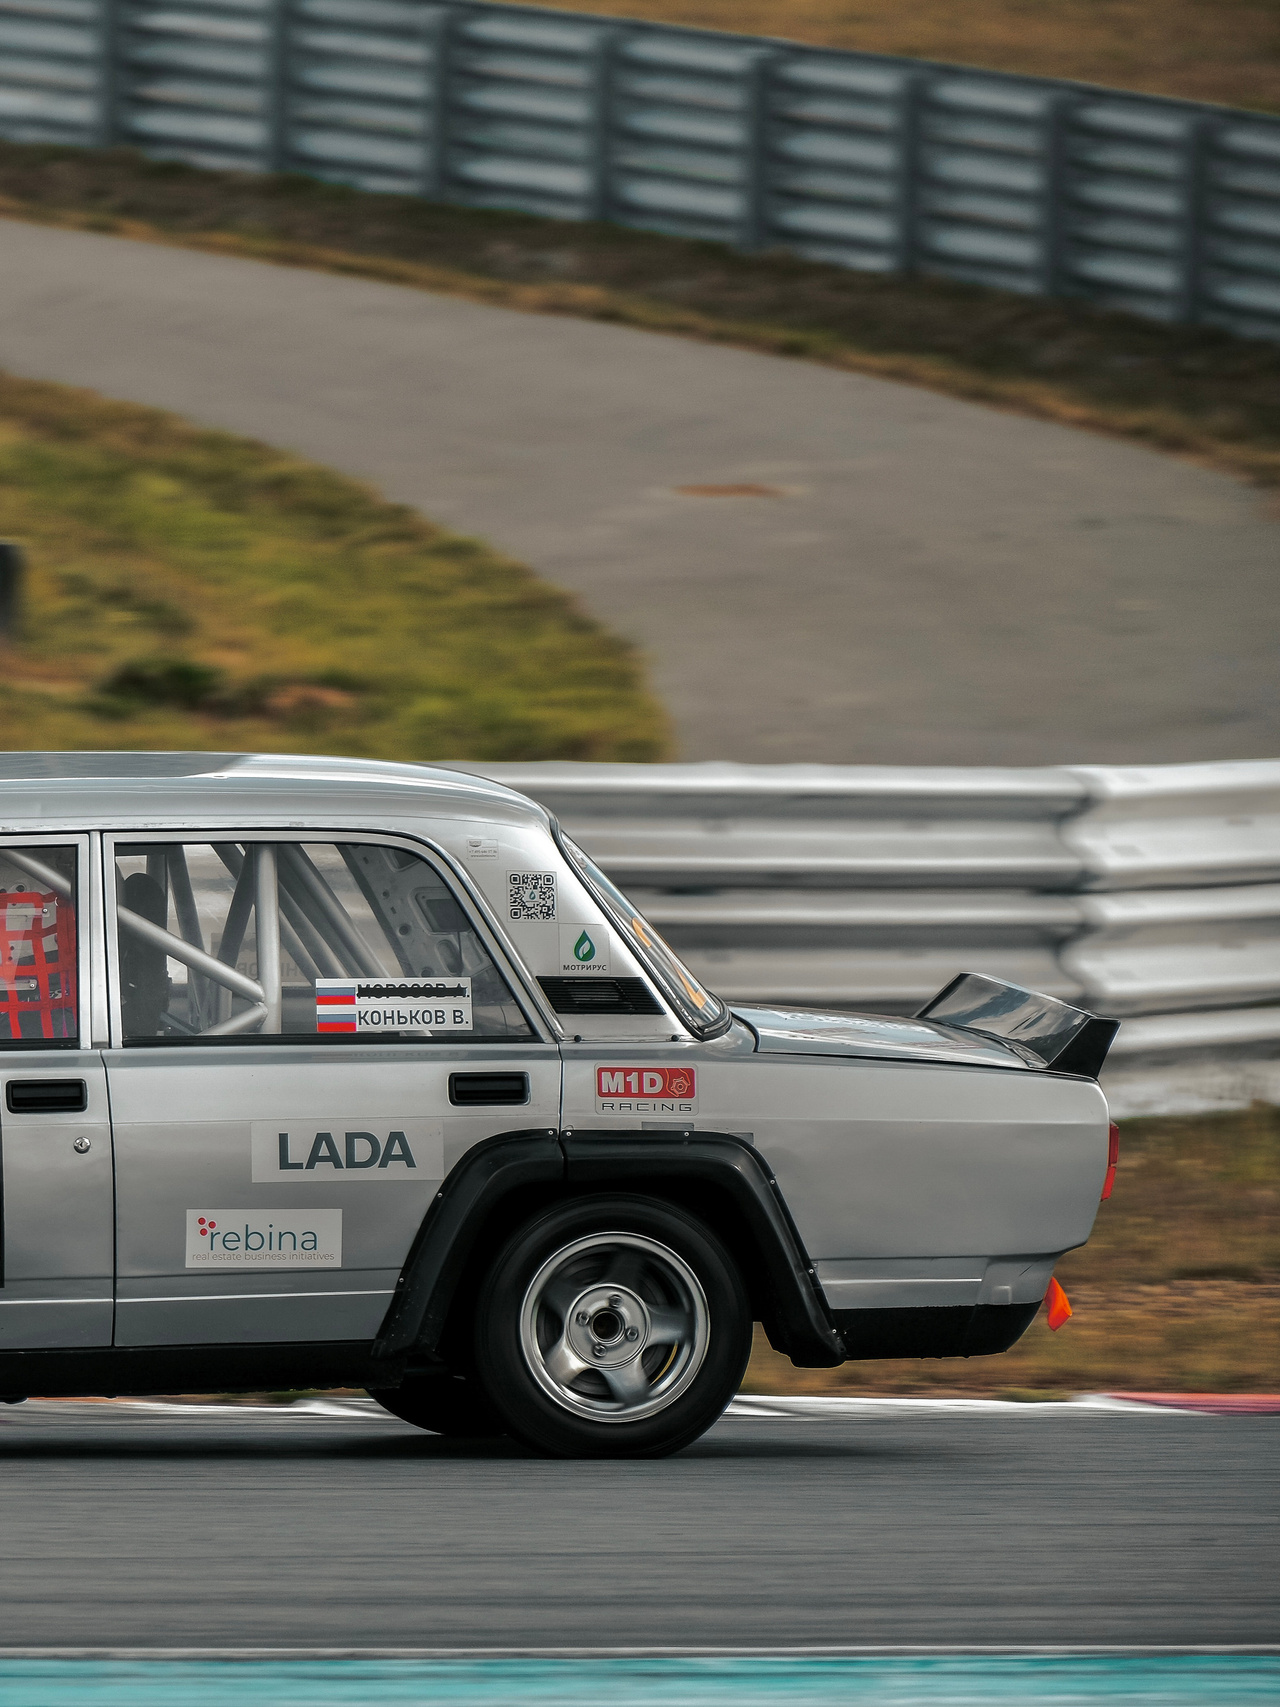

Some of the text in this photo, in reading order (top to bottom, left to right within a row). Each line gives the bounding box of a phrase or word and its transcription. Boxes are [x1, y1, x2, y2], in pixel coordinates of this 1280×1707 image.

[358, 1009, 469, 1026] КОНЬКОВ В.
[601, 1071, 664, 1094] M1D
[602, 1103, 692, 1112] RACING
[278, 1131, 417, 1170] LADA
[210, 1224, 318, 1251] rebina
[192, 1252, 334, 1260] real estate business initiatives
